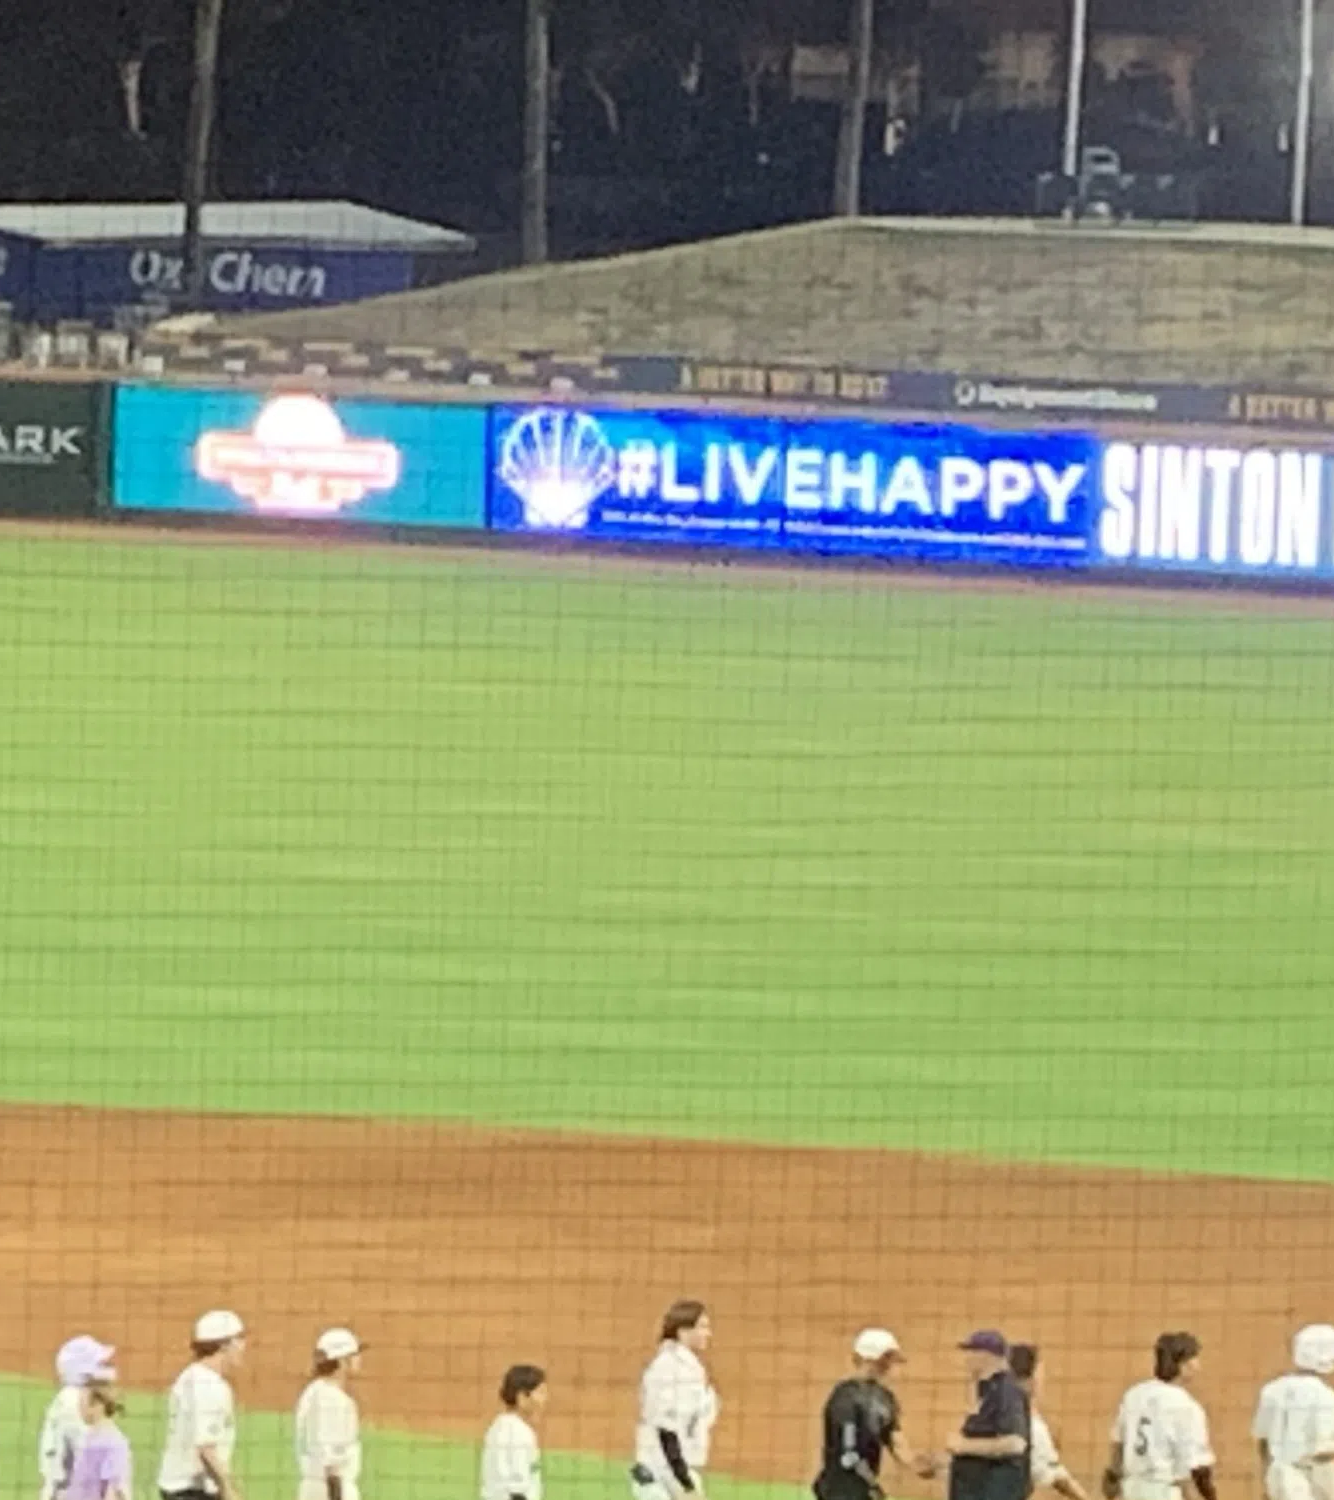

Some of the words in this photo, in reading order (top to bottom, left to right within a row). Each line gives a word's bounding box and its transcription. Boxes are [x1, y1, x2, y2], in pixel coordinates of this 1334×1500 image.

[617, 438, 1087, 524] #LIVEHAPPY
[1100, 442, 1323, 568] SINTON
[1134, 1416, 1152, 1457] 5
